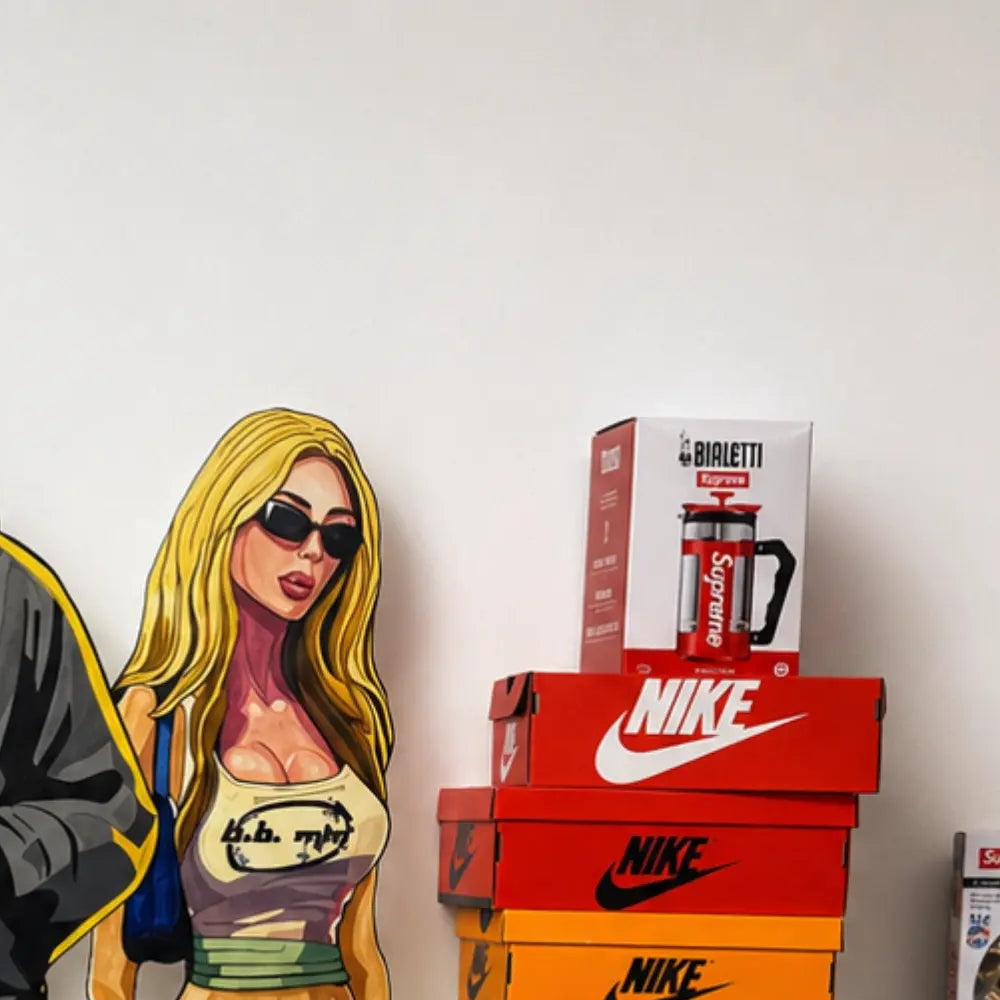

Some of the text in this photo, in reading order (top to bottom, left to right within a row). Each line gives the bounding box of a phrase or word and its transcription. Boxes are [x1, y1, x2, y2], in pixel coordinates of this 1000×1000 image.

[694, 440, 763, 468] BIALETTI
[704, 551, 733, 648] Supreme
[624, 678, 761, 736] NIKE
[616, 835, 709, 876] NIKE
[620, 957, 706, 993] NIKE
